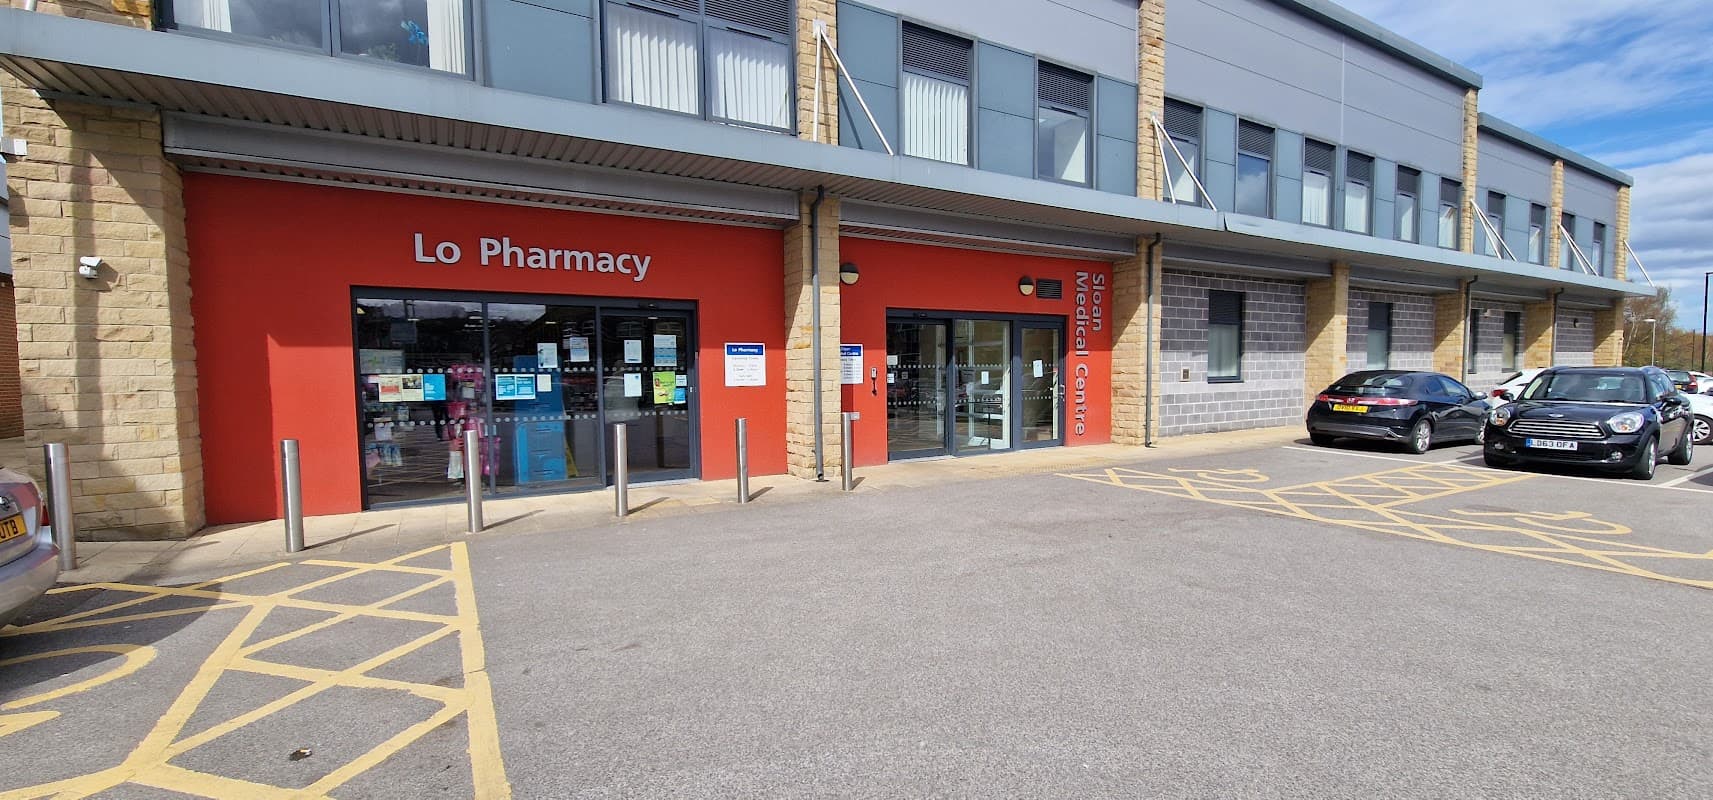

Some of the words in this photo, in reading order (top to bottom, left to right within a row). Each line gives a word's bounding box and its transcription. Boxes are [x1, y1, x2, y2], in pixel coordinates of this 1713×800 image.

[414, 232, 461, 264] Lo
[479, 237, 651, 282] Pharmacy
[1075, 271, 1089, 356] Medical
[1092, 273, 1105, 331] Sloan
[1075, 363, 1089, 436] Centre
